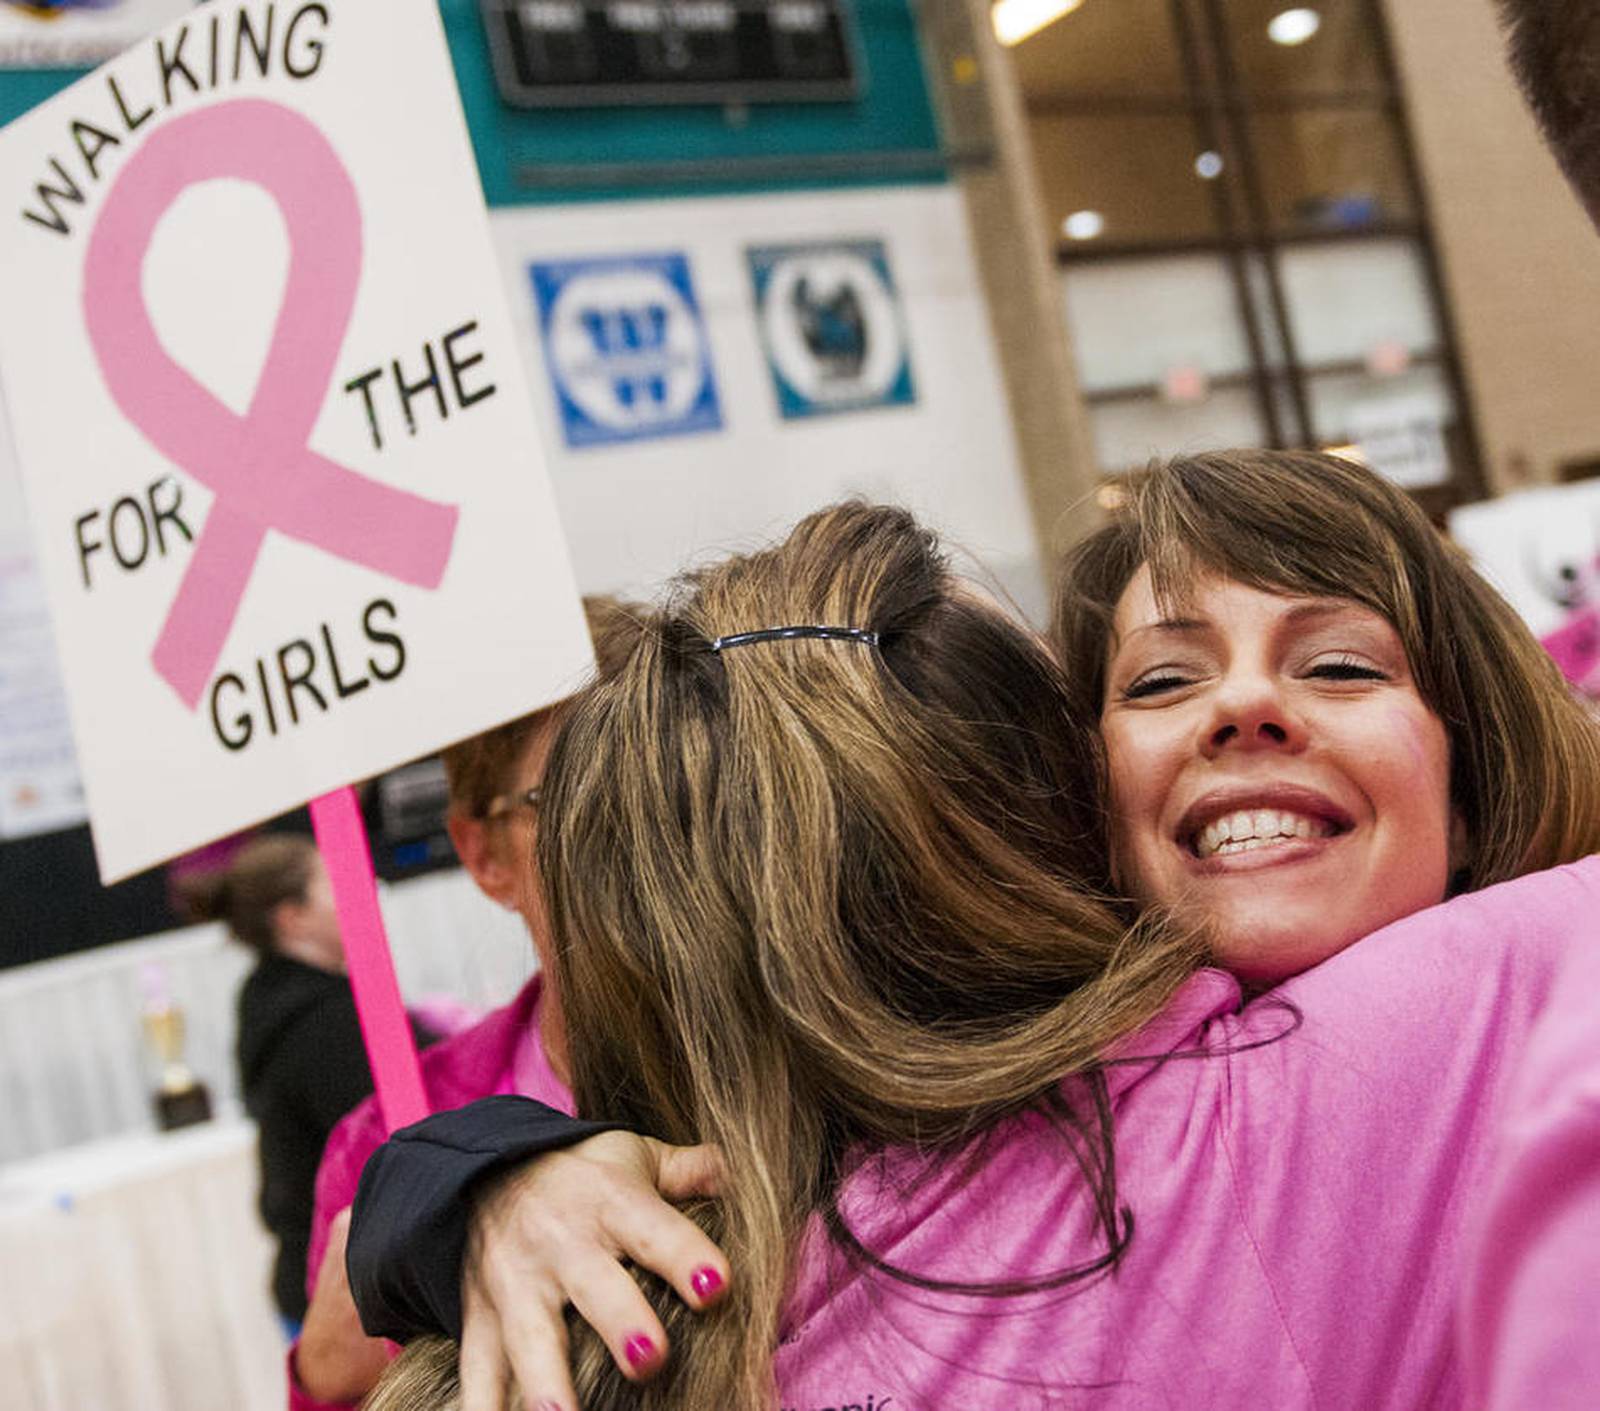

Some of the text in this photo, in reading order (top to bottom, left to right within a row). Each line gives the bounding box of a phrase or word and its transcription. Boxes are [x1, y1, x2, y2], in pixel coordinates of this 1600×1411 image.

[23, 2, 330, 237] WALKING
[75, 320, 497, 589] FOR THE
[209, 598, 407, 751] GIRLS
